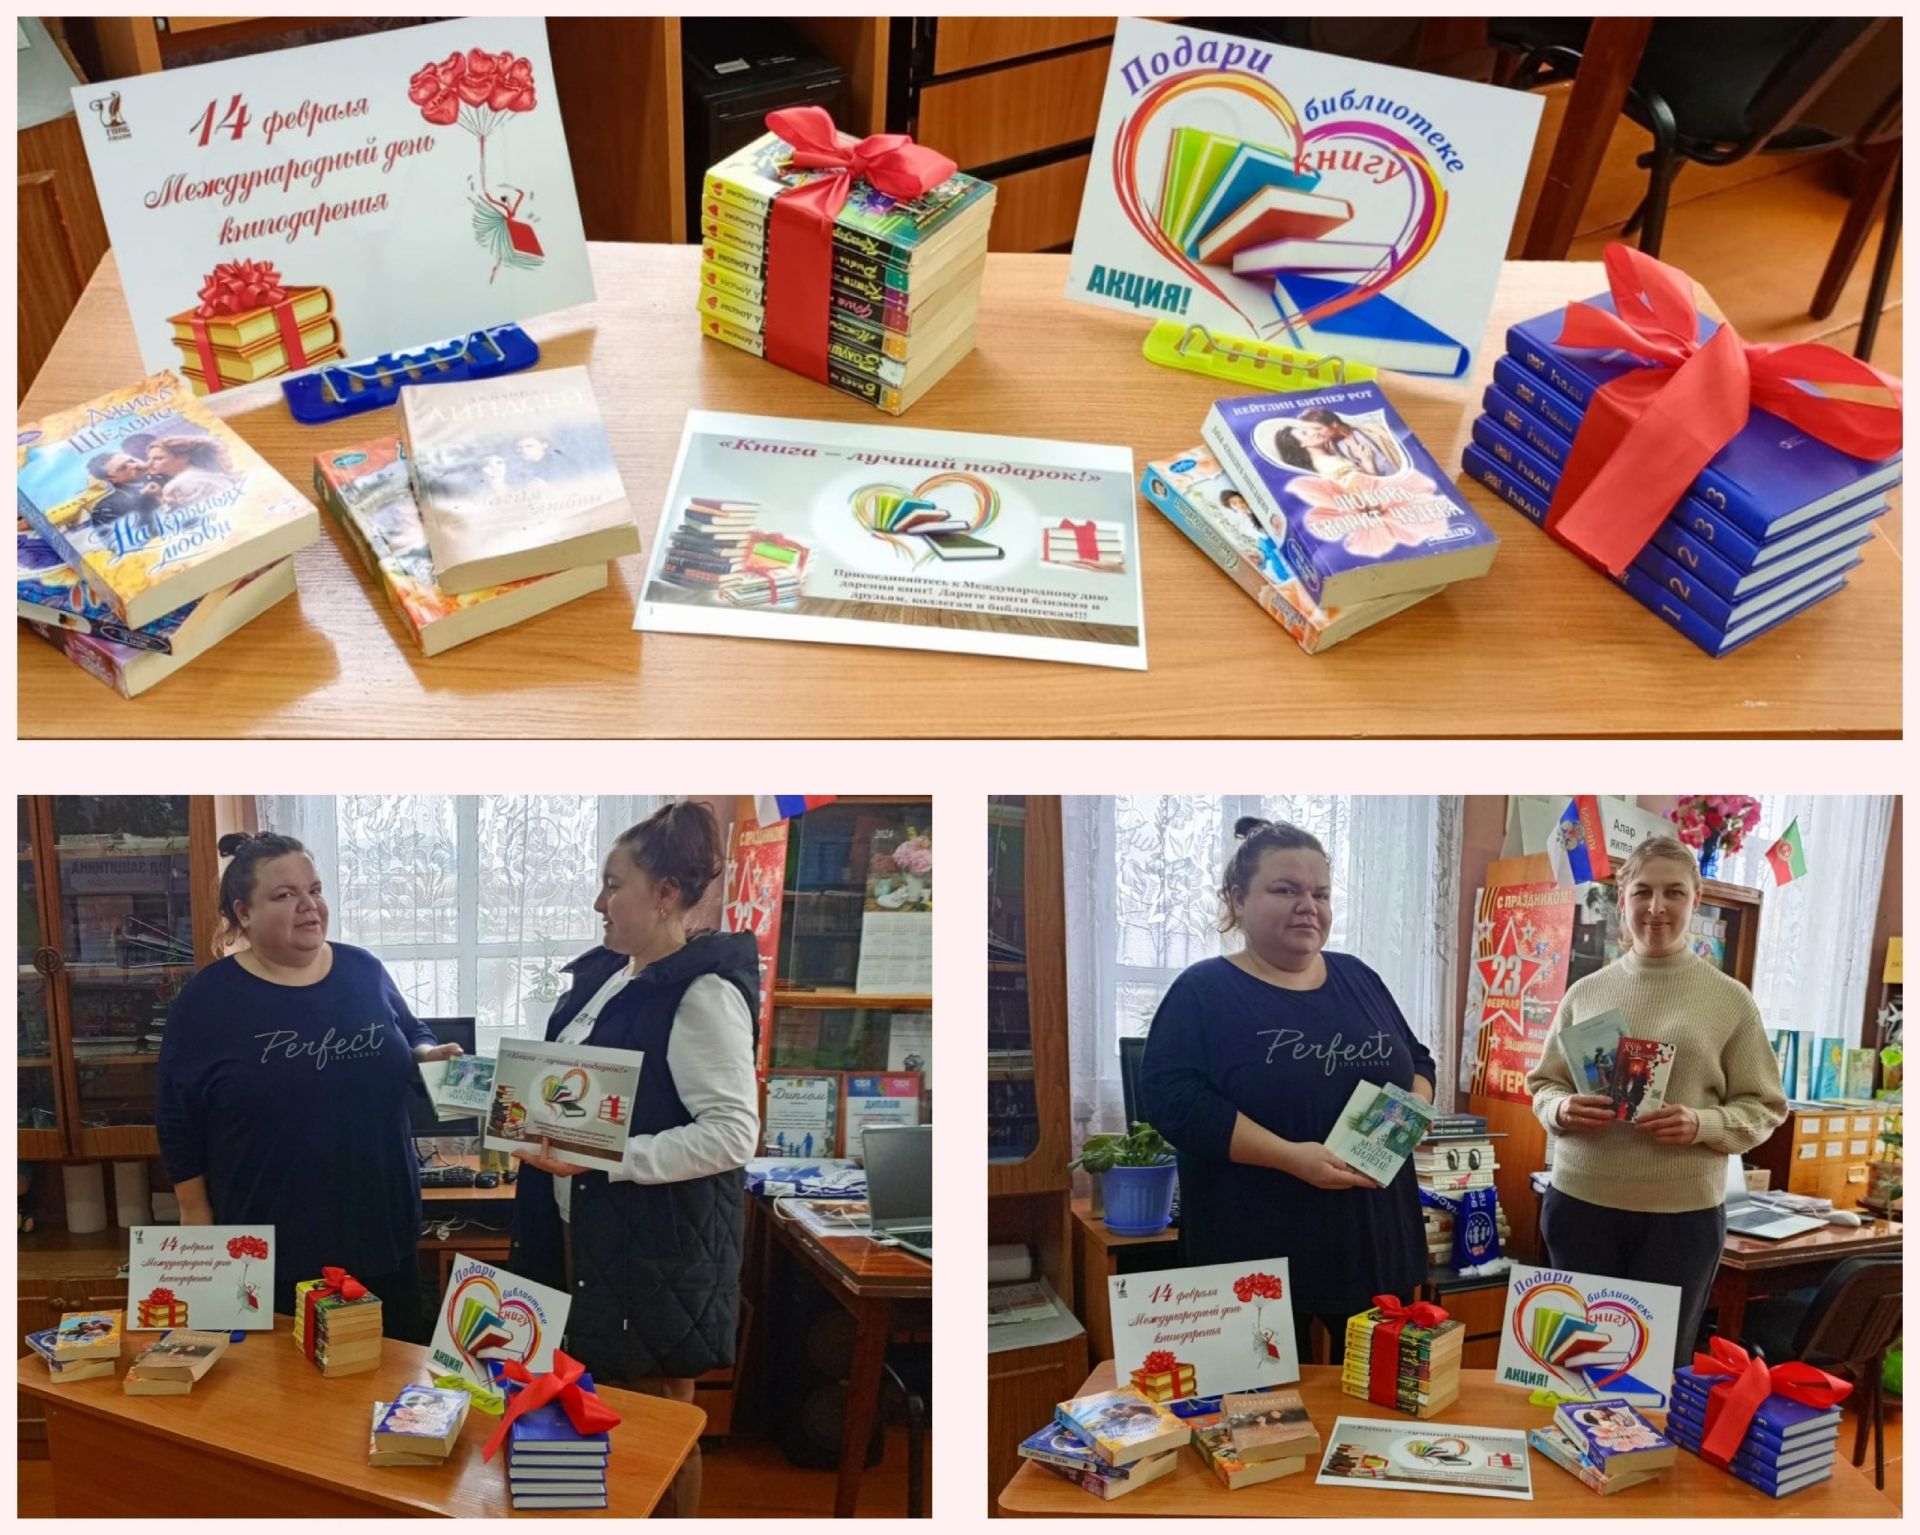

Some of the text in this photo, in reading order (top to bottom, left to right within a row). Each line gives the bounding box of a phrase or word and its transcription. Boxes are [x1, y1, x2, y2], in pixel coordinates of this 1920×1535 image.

[1120, 35, 1273, 97] Подари
[189, 93, 369, 147] 14 февраля
[1304, 88, 1465, 175] библиотеке
[144, 135, 435, 210] Международный день
[1293, 147, 1403, 183] книгу
[219, 193, 388, 245] книгодарения
[1086, 265, 1192, 315] АКЦИЯ!
[1233, 400, 1294, 416] КЕЙТЛИН
[1348, 390, 1373, 401] РОТ
[719, 439, 817, 457] «Книга
[847, 452, 955, 471] лучший
[964, 461, 1102, 483] подарок!»
[1706, 487, 1726, 510] 3
[1694, 518, 1715, 540] 3
[1678, 546, 1699, 568] 2
[833, 568, 949, 587] Присоединяйтесь
[962, 580, 1079, 600] Международному
[1080, 593, 1108, 602] дню
[839, 580, 895, 592] дарения
[938, 588, 986, 601] Дарите
[989, 594, 1028, 604] книги
[1032, 596, 1089, 610] близким
[1669, 577, 1690, 599] 2
[850, 591, 905, 604] друзьям,
[911, 596, 973, 609] коллегам
[987, 603, 1088, 619] библиотекам!!!
[1661, 603, 1682, 621] 1
[1613, 818, 1636, 839] Алар
[1497, 889, 1572, 909] С ПРАЗДНИКОМ!
[1489, 954, 1522, 997] 23
[254, 1022, 385, 1070] Perfect
[1256, 1030, 1392, 1076] Perfect
[771, 1087, 827, 1100] Диплом
[160, 1236, 179, 1251] 14
[454, 1262, 496, 1283] Подари
[1513, 1270, 1573, 1296] Подари
[502, 1287, 548, 1325] библиотеке
[1149, 1283, 1218, 1305] 14 февраля
[1587, 1288, 1654, 1321] библиотеке
[497, 1311, 529, 1327] книгу
[1128, 1304, 1242, 1328] Международный день
[1585, 1312, 1630, 1327] книгу
[1154, 1326, 1222, 1346] книгодарения
[432, 1349, 464, 1373] АКЦИЯ!
[1504, 1367, 1549, 1388] АКЦИЯ!
